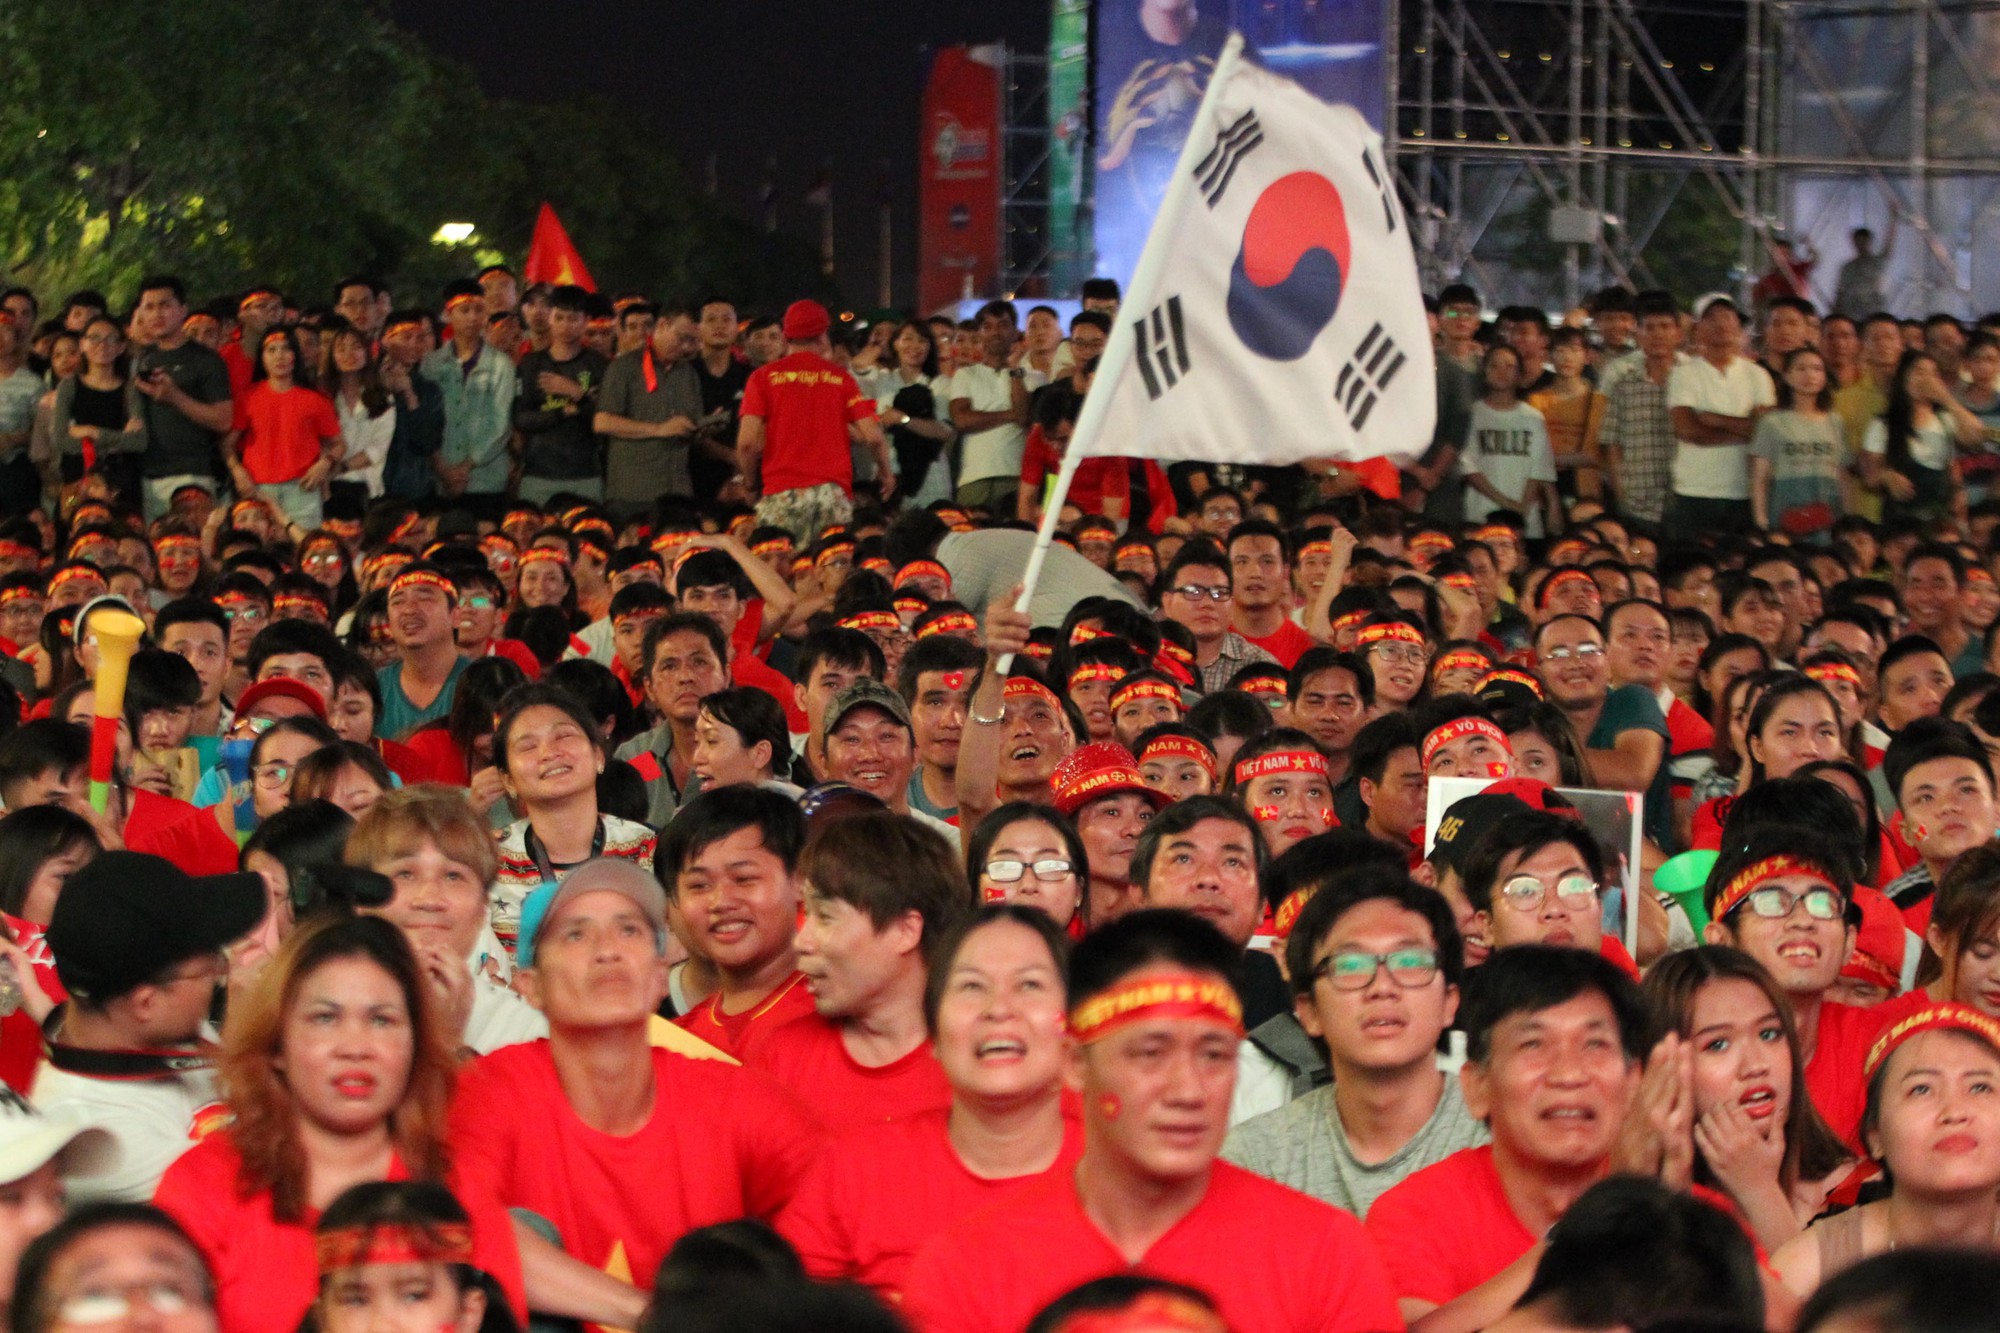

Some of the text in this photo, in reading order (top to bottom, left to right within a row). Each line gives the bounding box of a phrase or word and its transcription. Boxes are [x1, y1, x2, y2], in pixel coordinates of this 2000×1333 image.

[1003, 683, 1026, 694] AM
[1146, 740, 1181, 754] NAM
[1263, 755, 1289, 771] NAM
[1081, 774, 1110, 792] NAM
[1732, 861, 1768, 893] NAM
[1891, 1009, 1934, 1040] NAM
